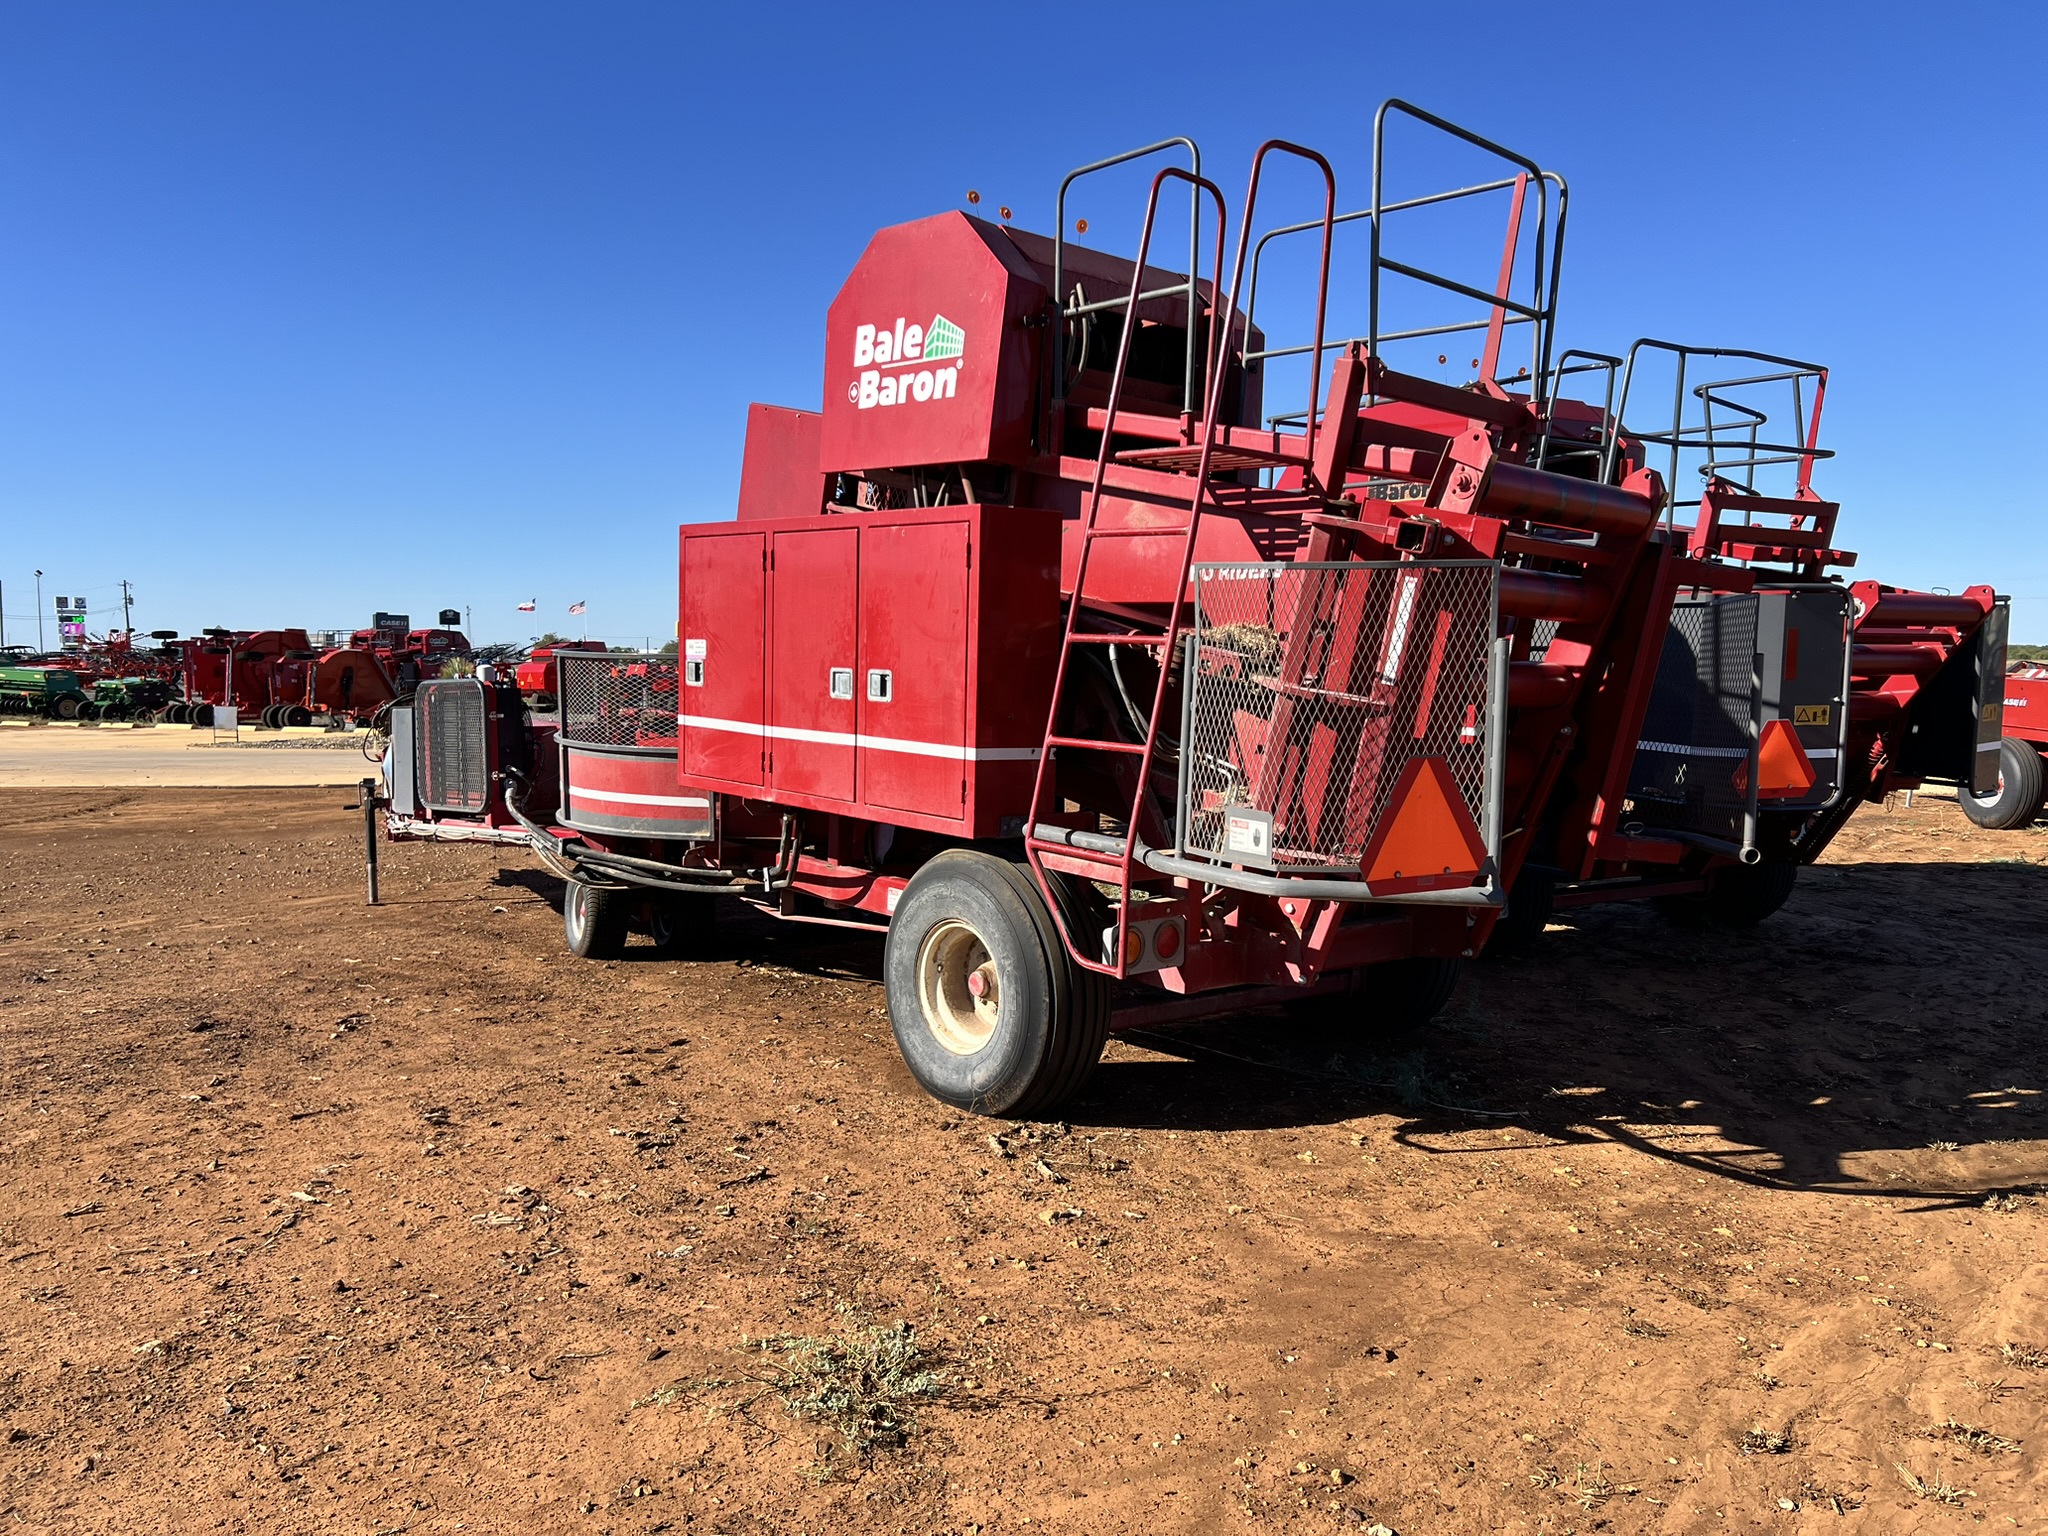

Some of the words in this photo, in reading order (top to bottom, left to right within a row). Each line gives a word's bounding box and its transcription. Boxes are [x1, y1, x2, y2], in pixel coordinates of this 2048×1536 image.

[853, 317, 924, 368] Bale
[858, 366, 958, 410] Baron
[2003, 698, 2020, 706] ASE
